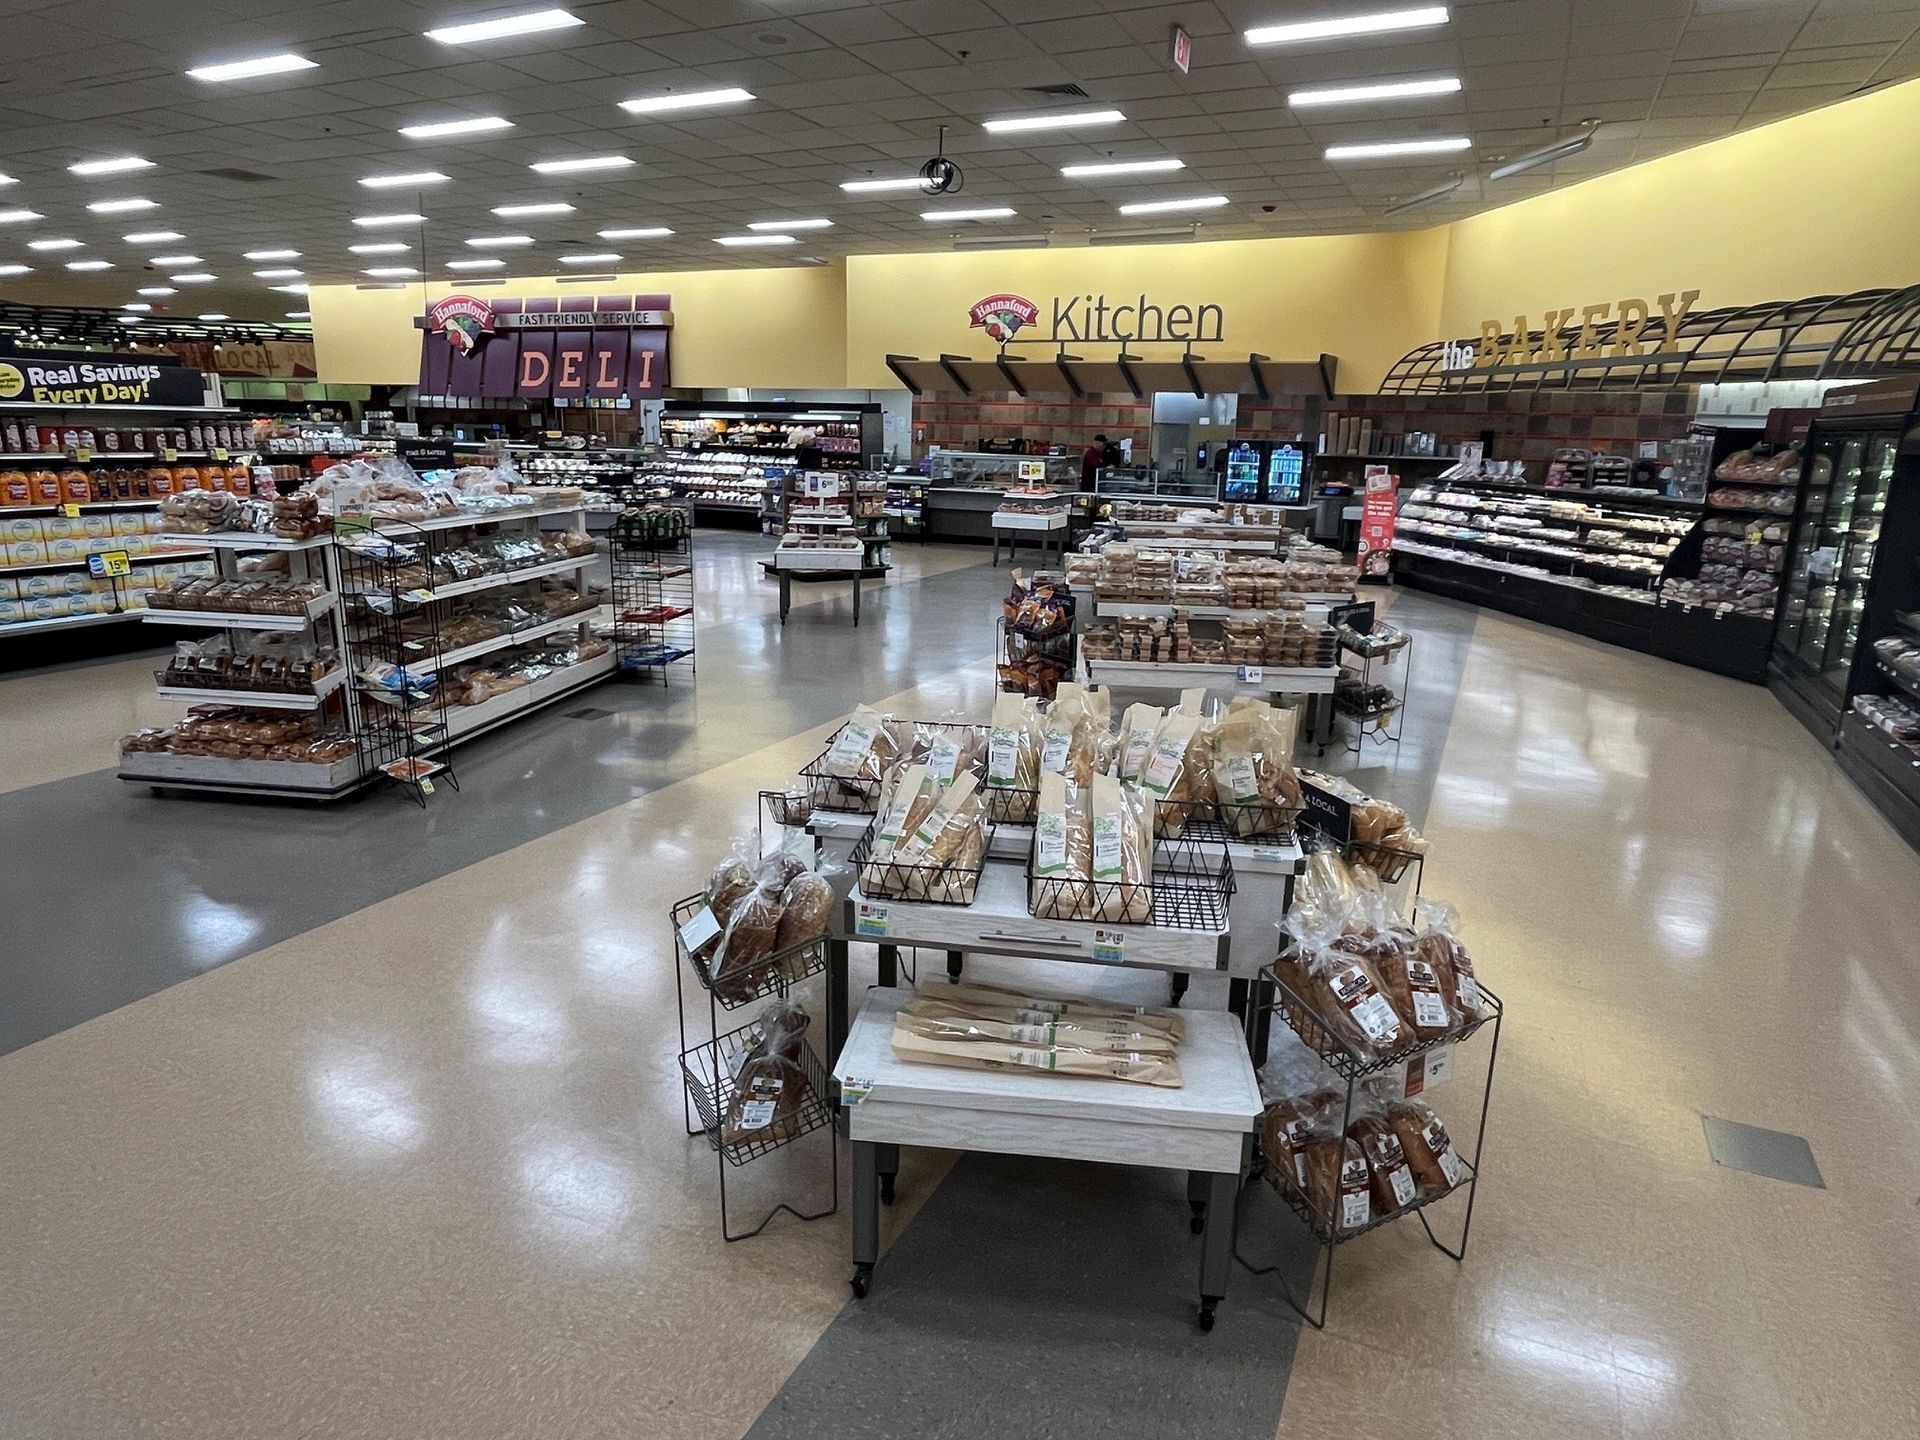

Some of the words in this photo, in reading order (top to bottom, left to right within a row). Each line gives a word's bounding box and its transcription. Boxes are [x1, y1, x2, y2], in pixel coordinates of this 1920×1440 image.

[435, 301, 488, 322] Hannaford
[519, 314, 544, 325] FAST
[548, 313, 598, 325] FRIENDLY
[601, 312, 650, 324] SERVICE
[976, 298, 1031, 318] Hannaford
[1053, 294, 1223, 340] Kitchen
[1442, 340, 1473, 370] the
[1476, 289, 1700, 368] BAKERY
[215, 350, 281, 369] LOCAL
[520, 351, 654, 388] DELI
[27, 364, 78, 386] Real
[79, 364, 161, 382] Savings
[32, 386, 98, 404] Every
[101, 381, 150, 402] Day!
[1311, 795, 1336, 812] LOCAL
